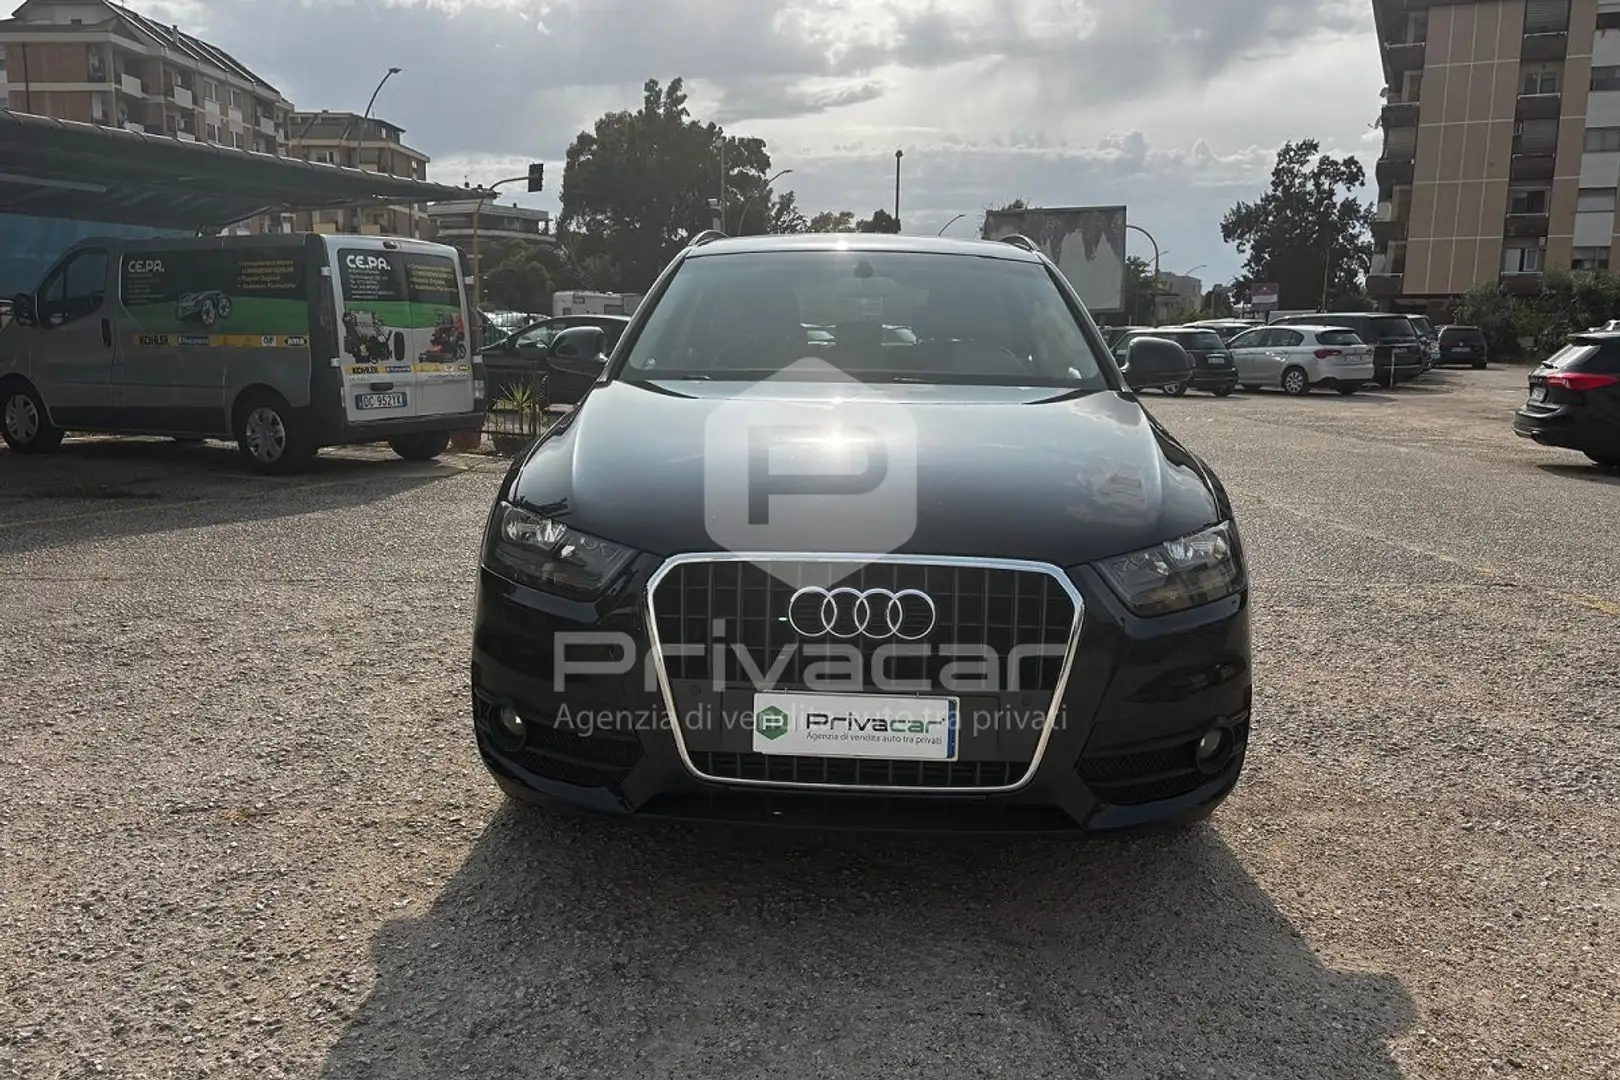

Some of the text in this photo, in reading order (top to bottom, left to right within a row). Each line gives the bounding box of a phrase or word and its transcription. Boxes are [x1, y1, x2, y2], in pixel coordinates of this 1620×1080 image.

[806, 712, 942, 734] Privacar
[806, 732, 942, 745] Agenzia di vendita auto tra privati
